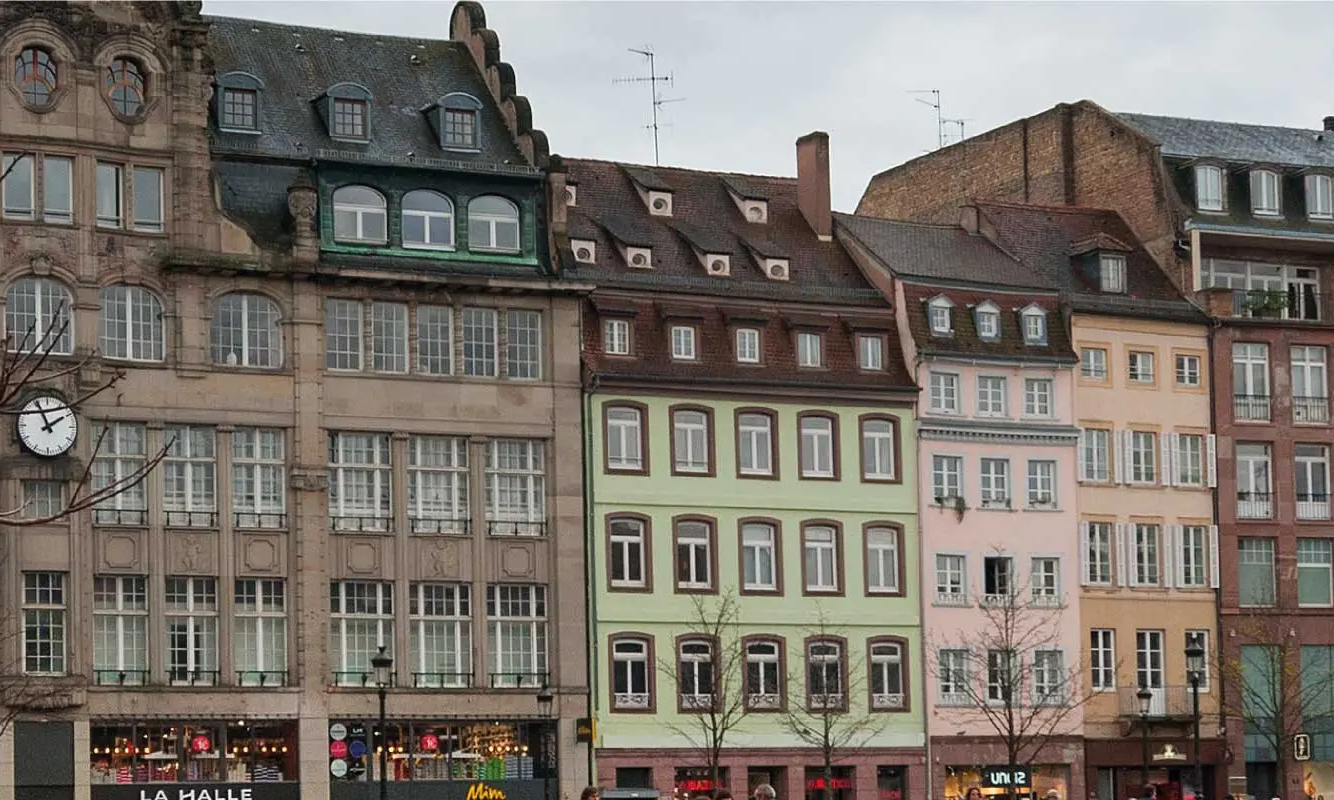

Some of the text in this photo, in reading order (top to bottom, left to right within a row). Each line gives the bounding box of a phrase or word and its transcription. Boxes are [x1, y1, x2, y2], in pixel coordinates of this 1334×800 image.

[140, 788, 252, 800] LA HALLE
[466, 783, 507, 800] Mim
